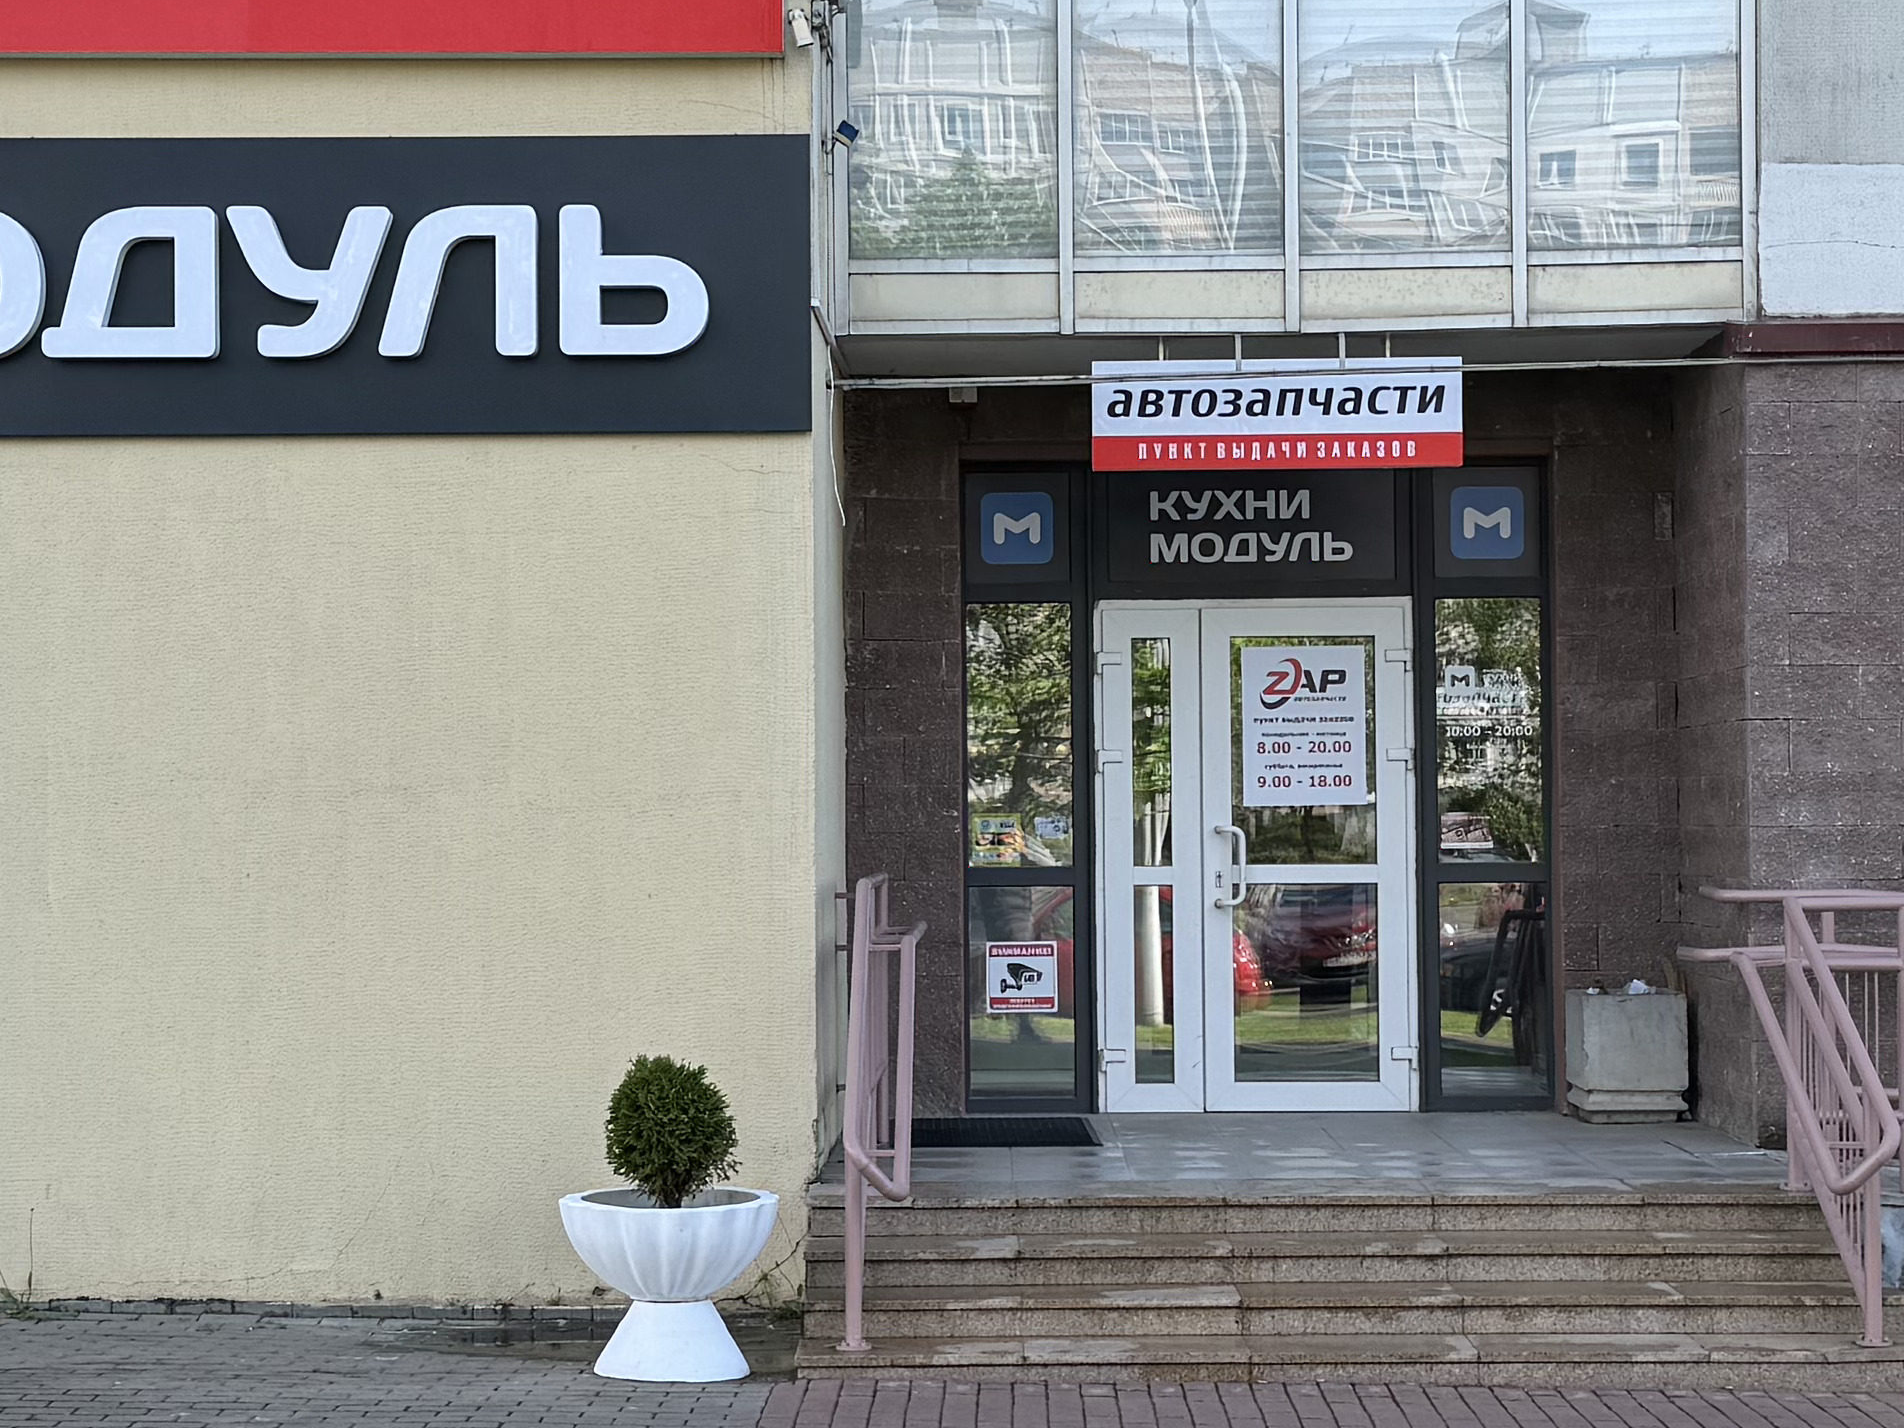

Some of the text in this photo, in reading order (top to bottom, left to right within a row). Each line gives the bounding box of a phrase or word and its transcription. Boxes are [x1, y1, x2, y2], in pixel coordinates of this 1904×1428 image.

[1106, 384, 1446, 419] автозапчасти
[1138, 439, 1417, 461] ПУНКТ ВЫДАЧИ ЗАКАЗОВ
[1149, 489, 1310, 521] КУХНИ
[1149, 531, 1354, 564] МОДУЛЬ
[1445, 725, 1481, 737] 10:00
[1494, 725, 1533, 737] 20:00
[1257, 741, 1291, 754] 8.00
[1308, 740, 1352, 754] 20.00
[1257, 775, 1292, 788] 9.00
[1309, 774, 1352, 788] 18.00
